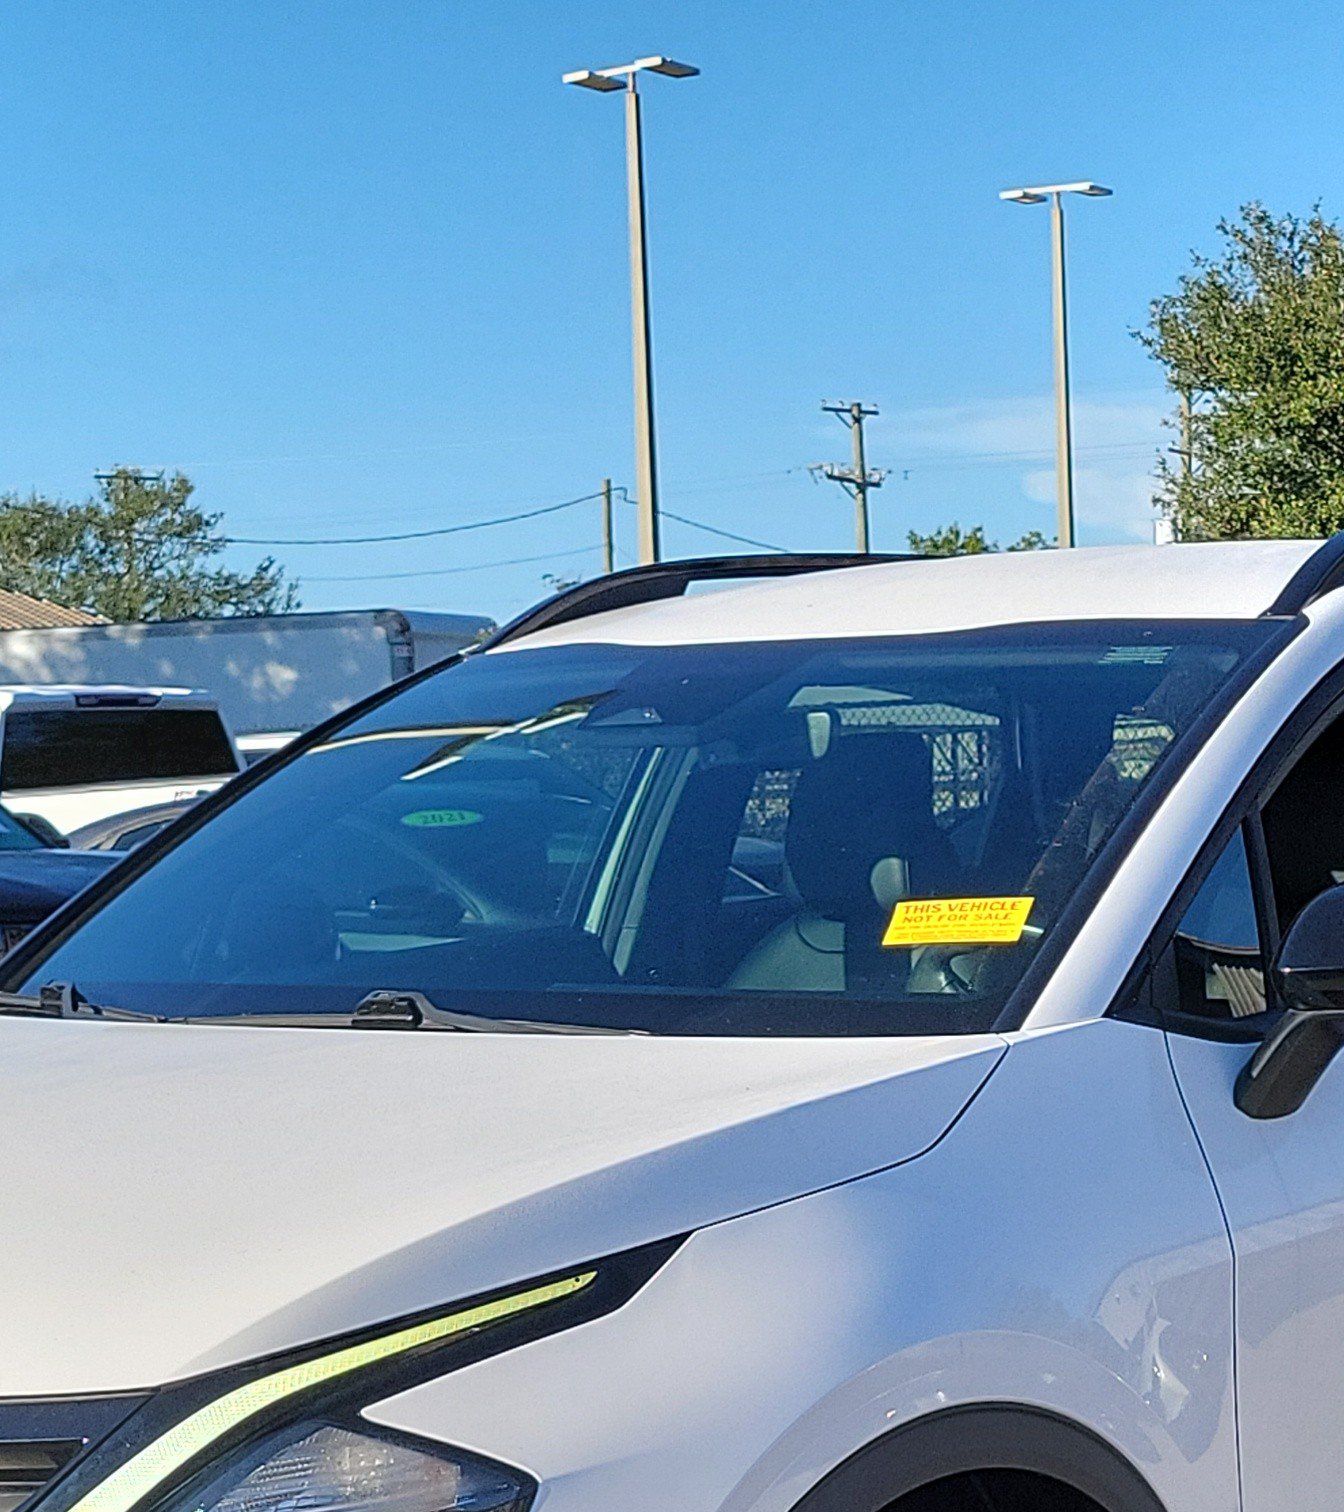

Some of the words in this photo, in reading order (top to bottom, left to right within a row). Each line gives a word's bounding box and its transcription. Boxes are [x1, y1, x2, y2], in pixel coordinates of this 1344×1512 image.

[904, 904, 941, 914] THIS
[948, 901, 1022, 912] VEHICLE
[903, 914, 931, 924] NOT
[938, 913, 968, 922] FOR
[974, 912, 1012, 921] SALE
